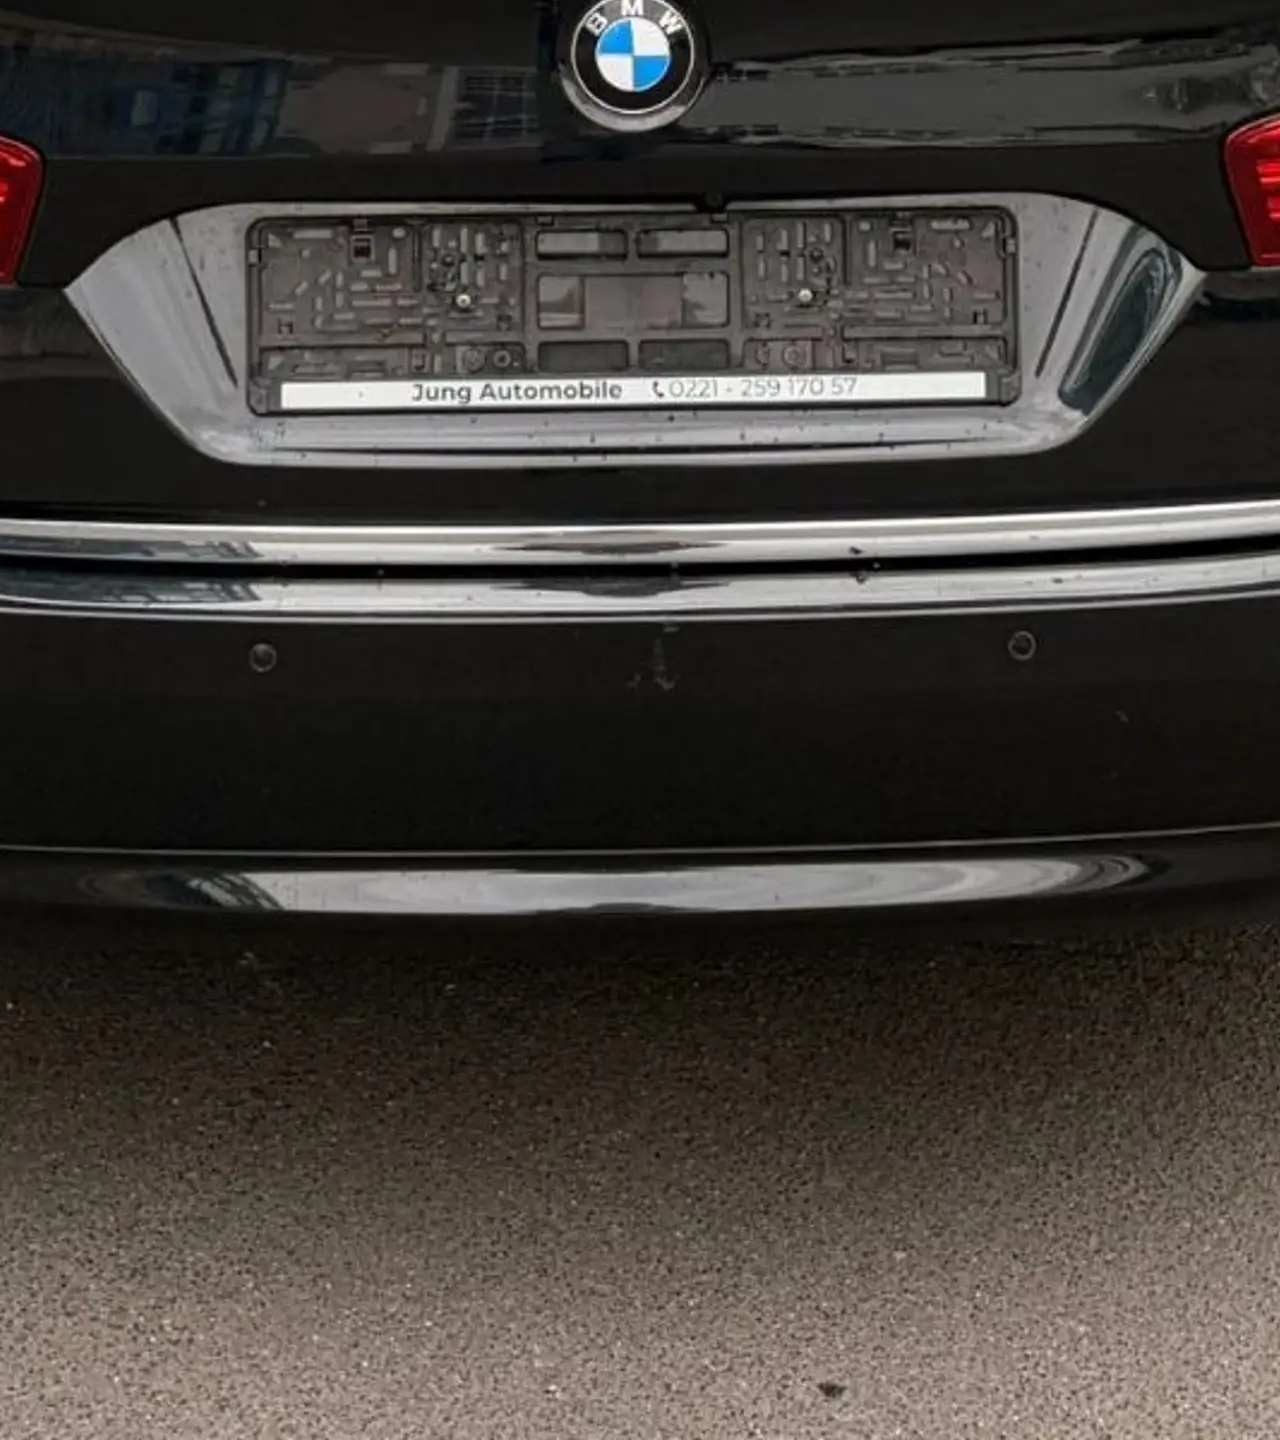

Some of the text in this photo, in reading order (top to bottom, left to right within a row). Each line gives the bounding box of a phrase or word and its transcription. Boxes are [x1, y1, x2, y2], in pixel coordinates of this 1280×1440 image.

[411, 378, 623, 405] Jung Automobile
[668, 378, 719, 399] 0221
[740, 377, 782, 398] 259
[787, 376, 825, 397] 170
[830, 375, 859, 397] 57
